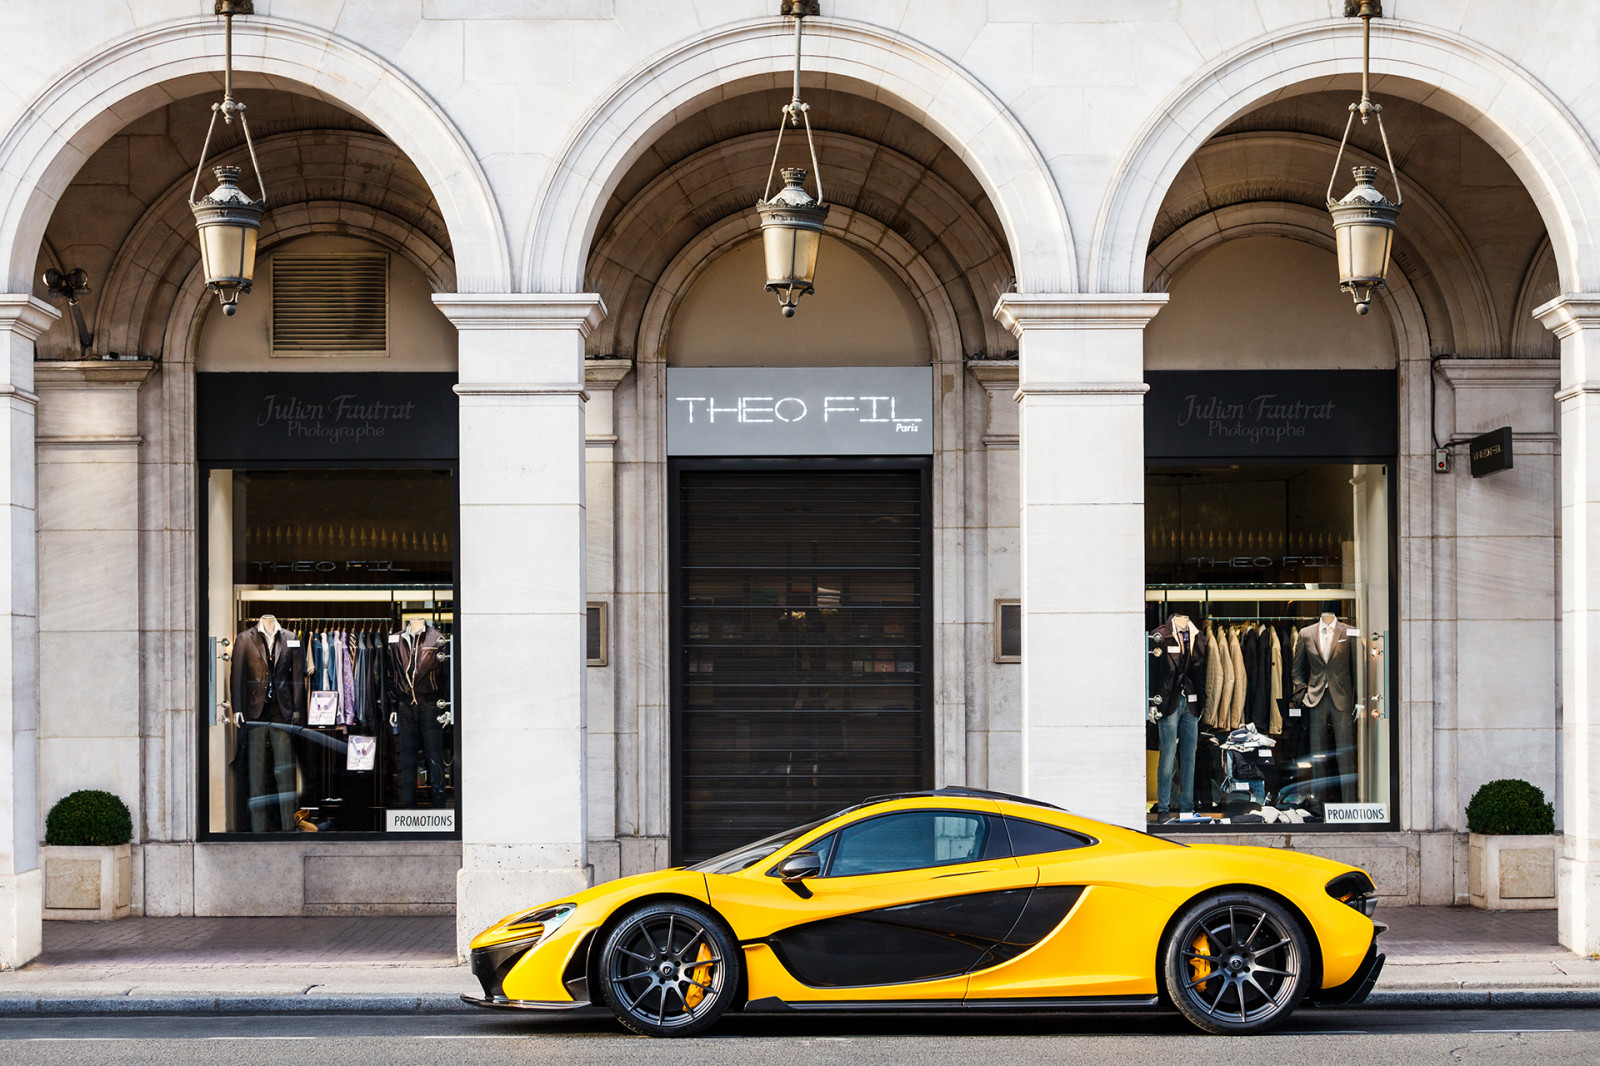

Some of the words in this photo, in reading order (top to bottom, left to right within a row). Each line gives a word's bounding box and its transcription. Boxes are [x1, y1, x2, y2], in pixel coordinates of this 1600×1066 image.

[257, 394, 324, 426] Julien
[328, 394, 416, 422] Fautrat
[676, 397, 808, 423] THEO
[824, 397, 923, 423] FIL
[1178, 394, 1245, 426] Julien
[1248, 394, 1337, 422] Fautrat
[287, 420, 385, 444] Photographe
[895, 422, 919, 433] Paris
[1208, 420, 1306, 444] Photographe
[250, 560, 337, 573] THEO
[394, 815, 453, 827] PROMOTIONS
[1327, 808, 1385, 820] PROMOTIONS
